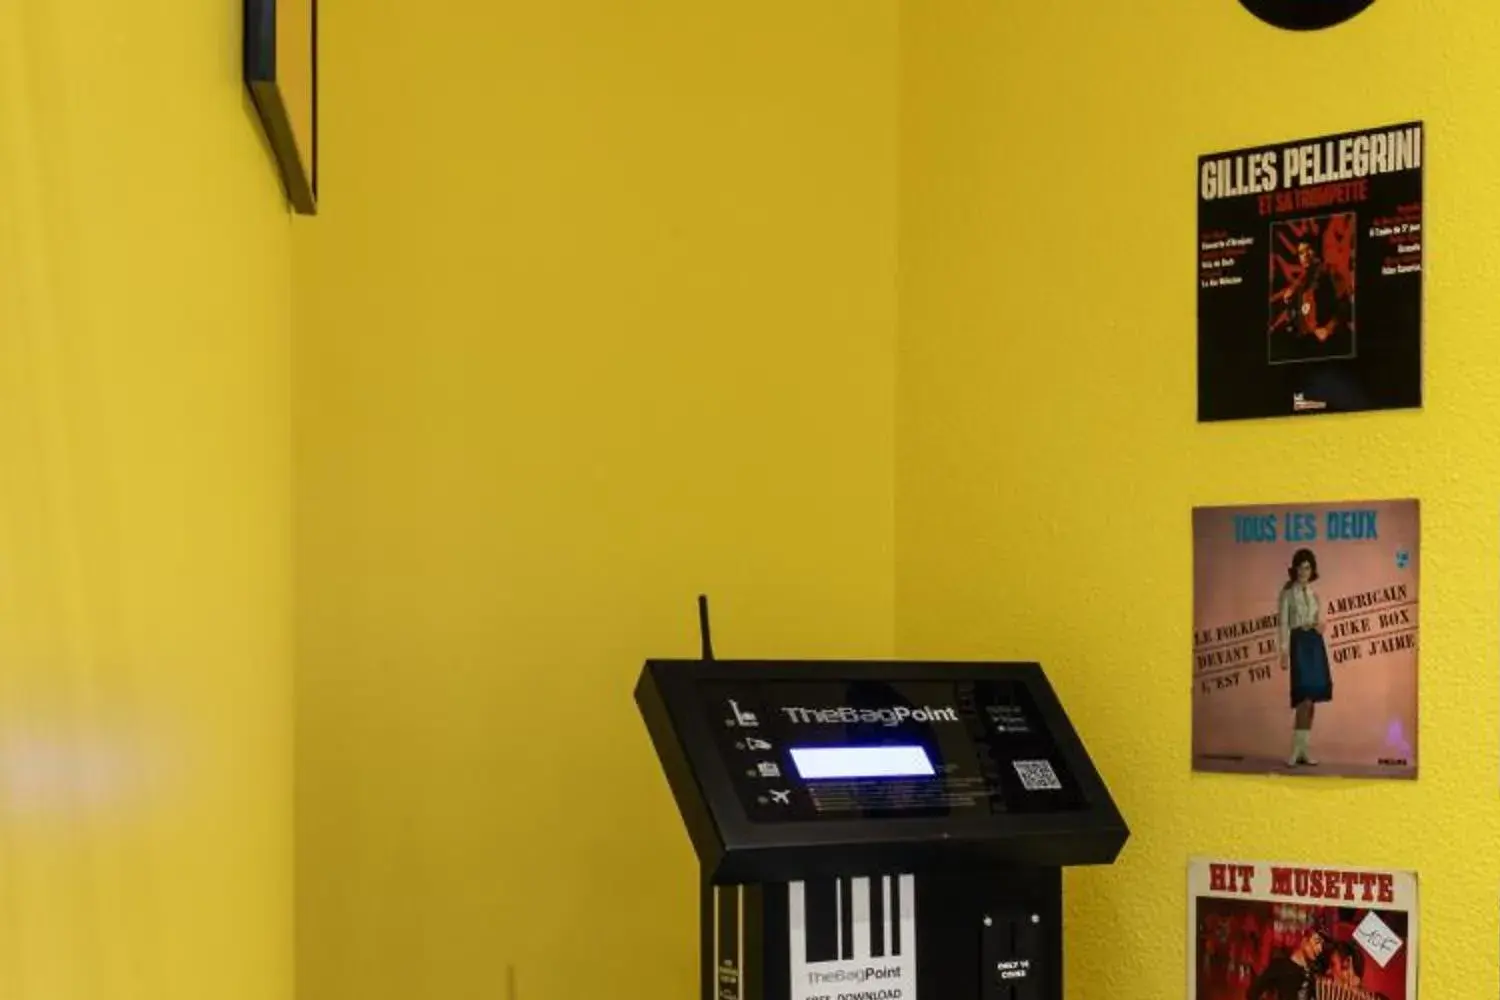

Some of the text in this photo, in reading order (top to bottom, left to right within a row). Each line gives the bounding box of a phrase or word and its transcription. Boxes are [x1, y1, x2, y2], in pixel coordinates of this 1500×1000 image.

[1201, 127, 1421, 200] GILLES PELLEGRINI
[1234, 510, 1379, 543] TOUS LES DEUX
[1327, 584, 1408, 615] AMERICAIN
[781, 705, 959, 727] TheBagPoint
[1209, 864, 1394, 902] HIT MUSETTE
[808, 966, 902, 985] TheBagPoint
